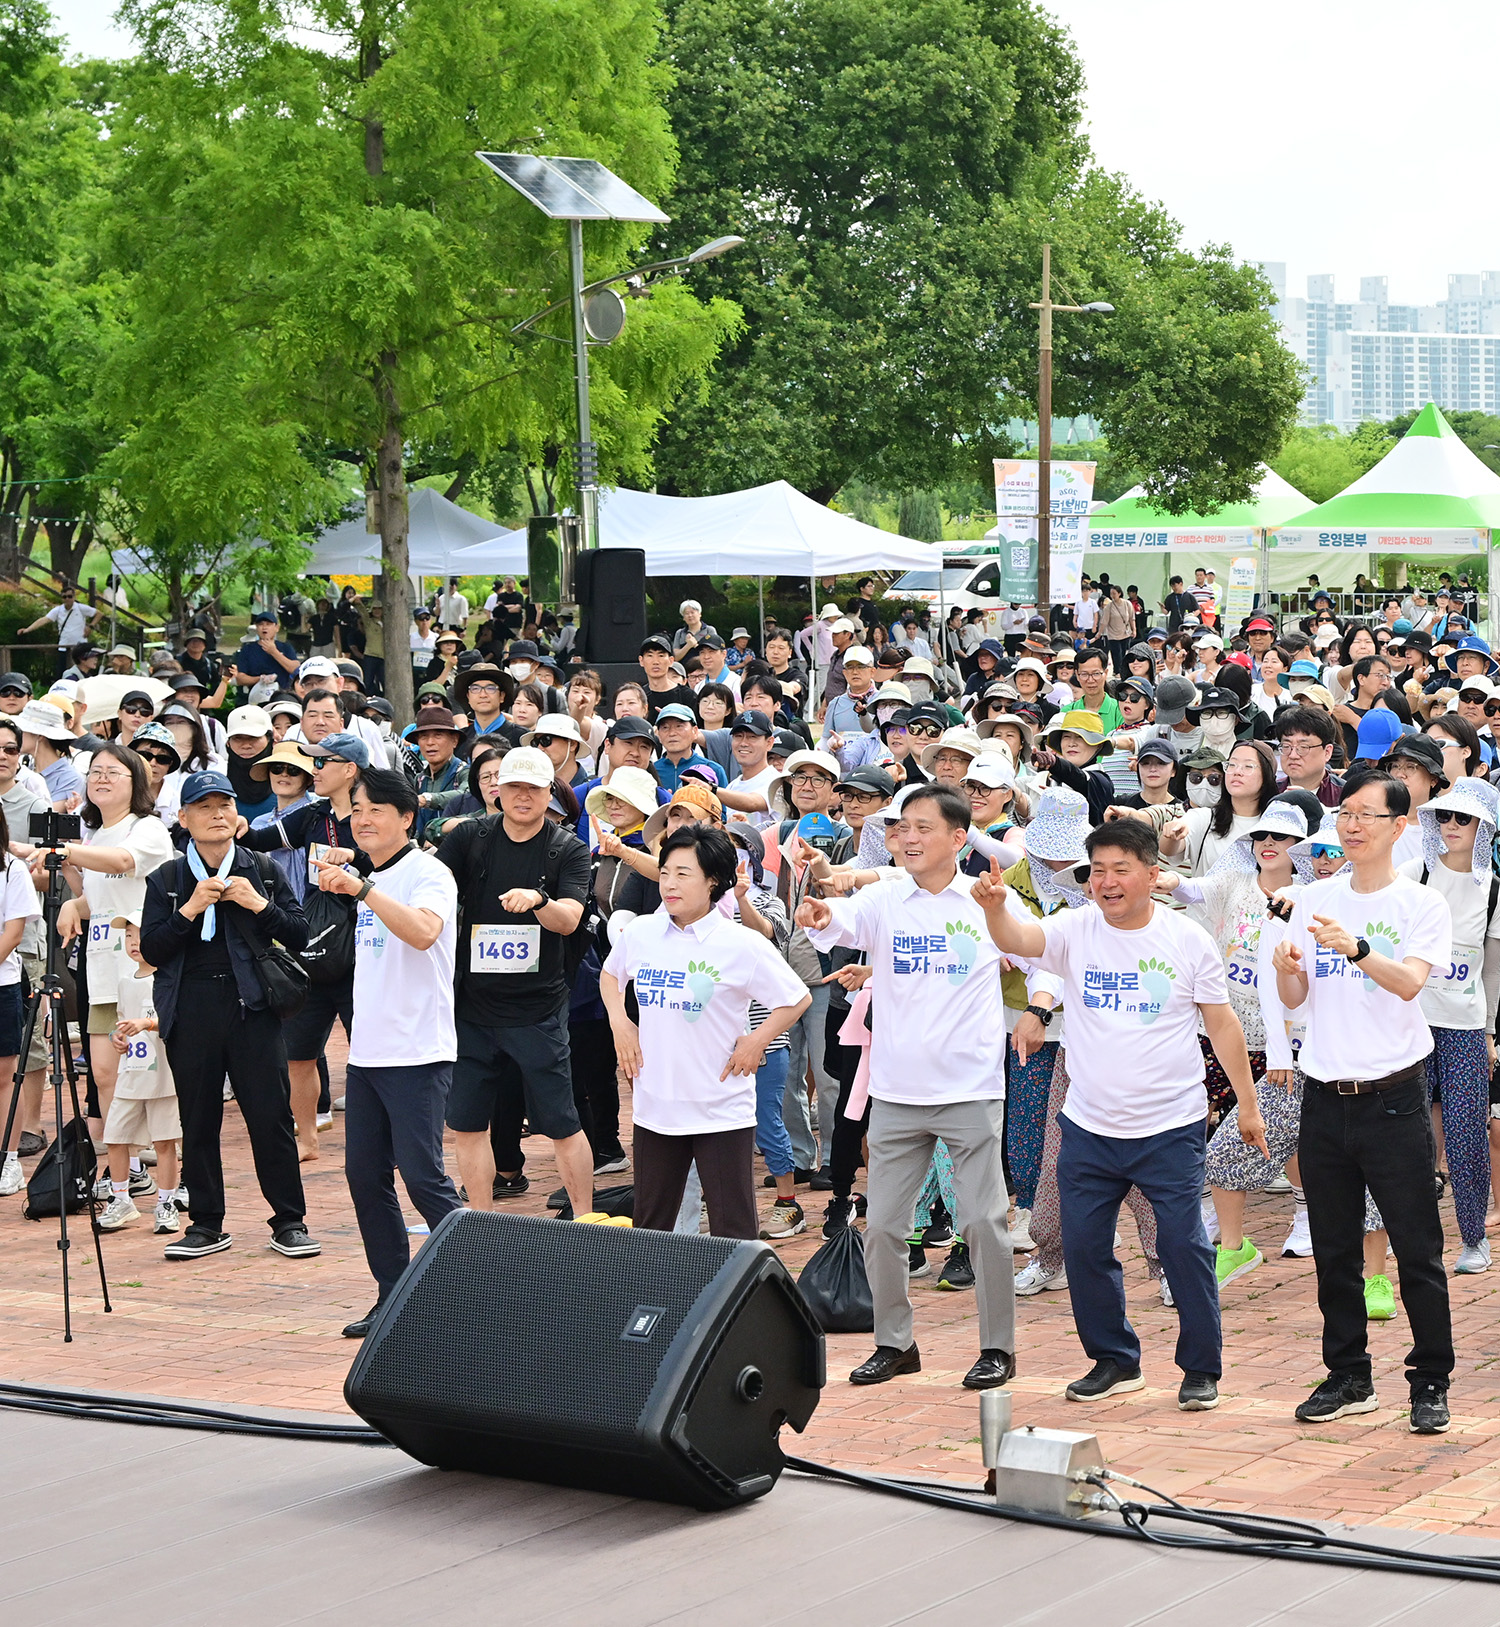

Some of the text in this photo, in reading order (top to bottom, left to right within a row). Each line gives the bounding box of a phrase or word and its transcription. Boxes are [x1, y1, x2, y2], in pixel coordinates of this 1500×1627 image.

[1090, 532, 1137, 547] 운영본부
[1174, 534, 1203, 544] (단체접수
[1204, 534, 1226, 544] 확인처)
[1318, 532, 1433, 548] 운영본부 (개인접수 확인처)
[478, 941, 529, 960] 1463
[892, 935, 948, 954] 맨발로
[892, 955, 969, 975] 놀자 in 울산
[1315, 957, 1361, 979] 놀자 in
[636, 968, 686, 989] 맨발로
[1084, 970, 1139, 991] 맨발로
[636, 988, 703, 1012] 놀자 in 울산
[1082, 990, 1161, 1014] 놀자 in 울산
[633, 1315, 650, 1331] JBL
